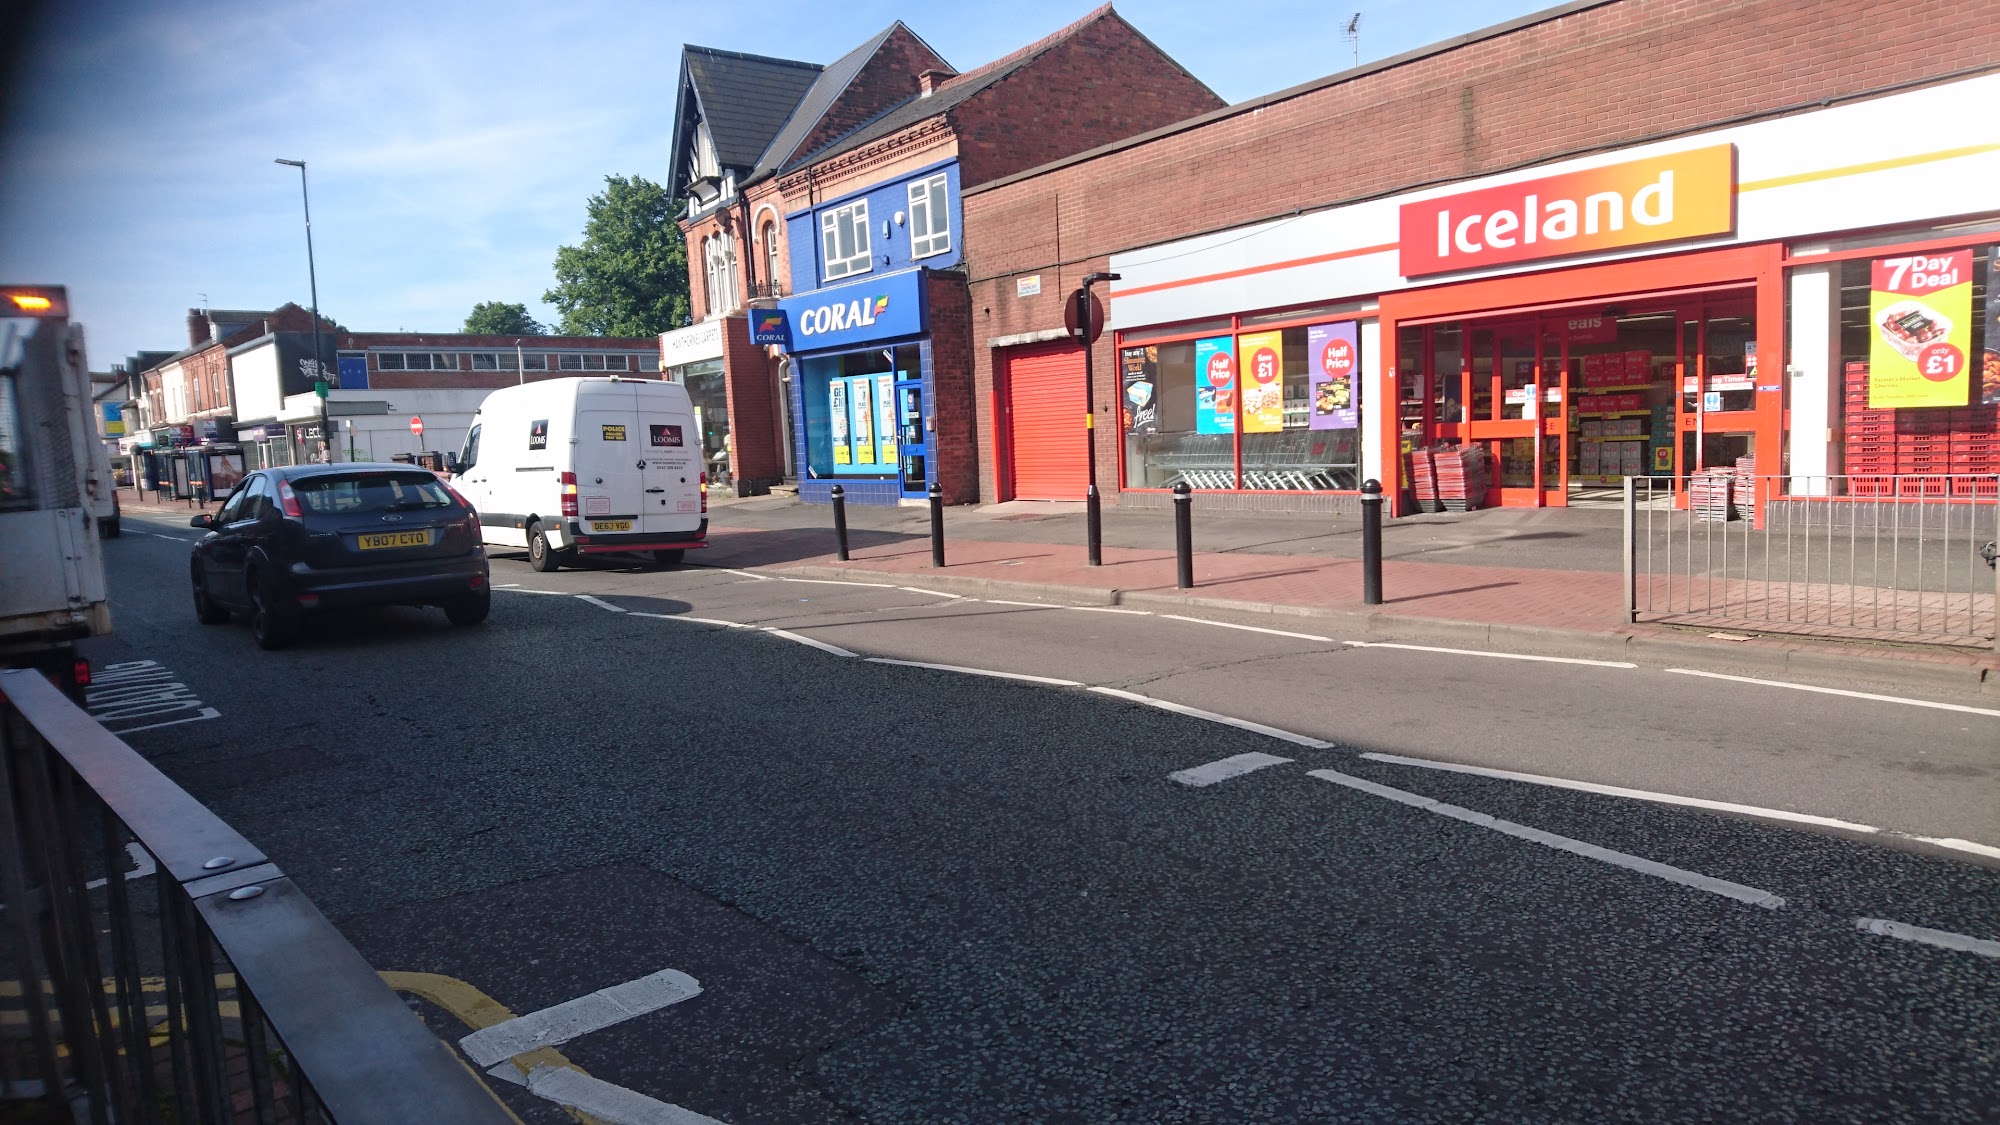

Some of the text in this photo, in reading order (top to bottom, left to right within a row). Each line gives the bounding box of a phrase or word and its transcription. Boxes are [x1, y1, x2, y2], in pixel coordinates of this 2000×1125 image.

[1437, 169, 1674, 257] Iceland
[1884, 255, 1953, 291] 7 Day
[1911, 268, 1958, 289] Deal
[800, 297, 876, 336] CORAL
[756, 333, 786, 342] CORAL
[1327, 346, 1348, 359] Half
[1931, 347, 1949, 355] only
[1212, 358, 1229, 370] Half
[1257, 354, 1272, 362] Save
[1326, 358, 1350, 369] Price
[1926, 354, 1954, 374] £1
[1210, 369, 1231, 380] Price
[1257, 362, 1273, 378] £1
[1723, 375, 1745, 383] Times
[1133, 403, 1156, 428] free!
[530, 435, 546, 445] LOOMIS
[594, 522, 614, 530] DE63
[363, 532, 424, 547] YB07 CTO
[84, 659, 222, 735] LOADING
